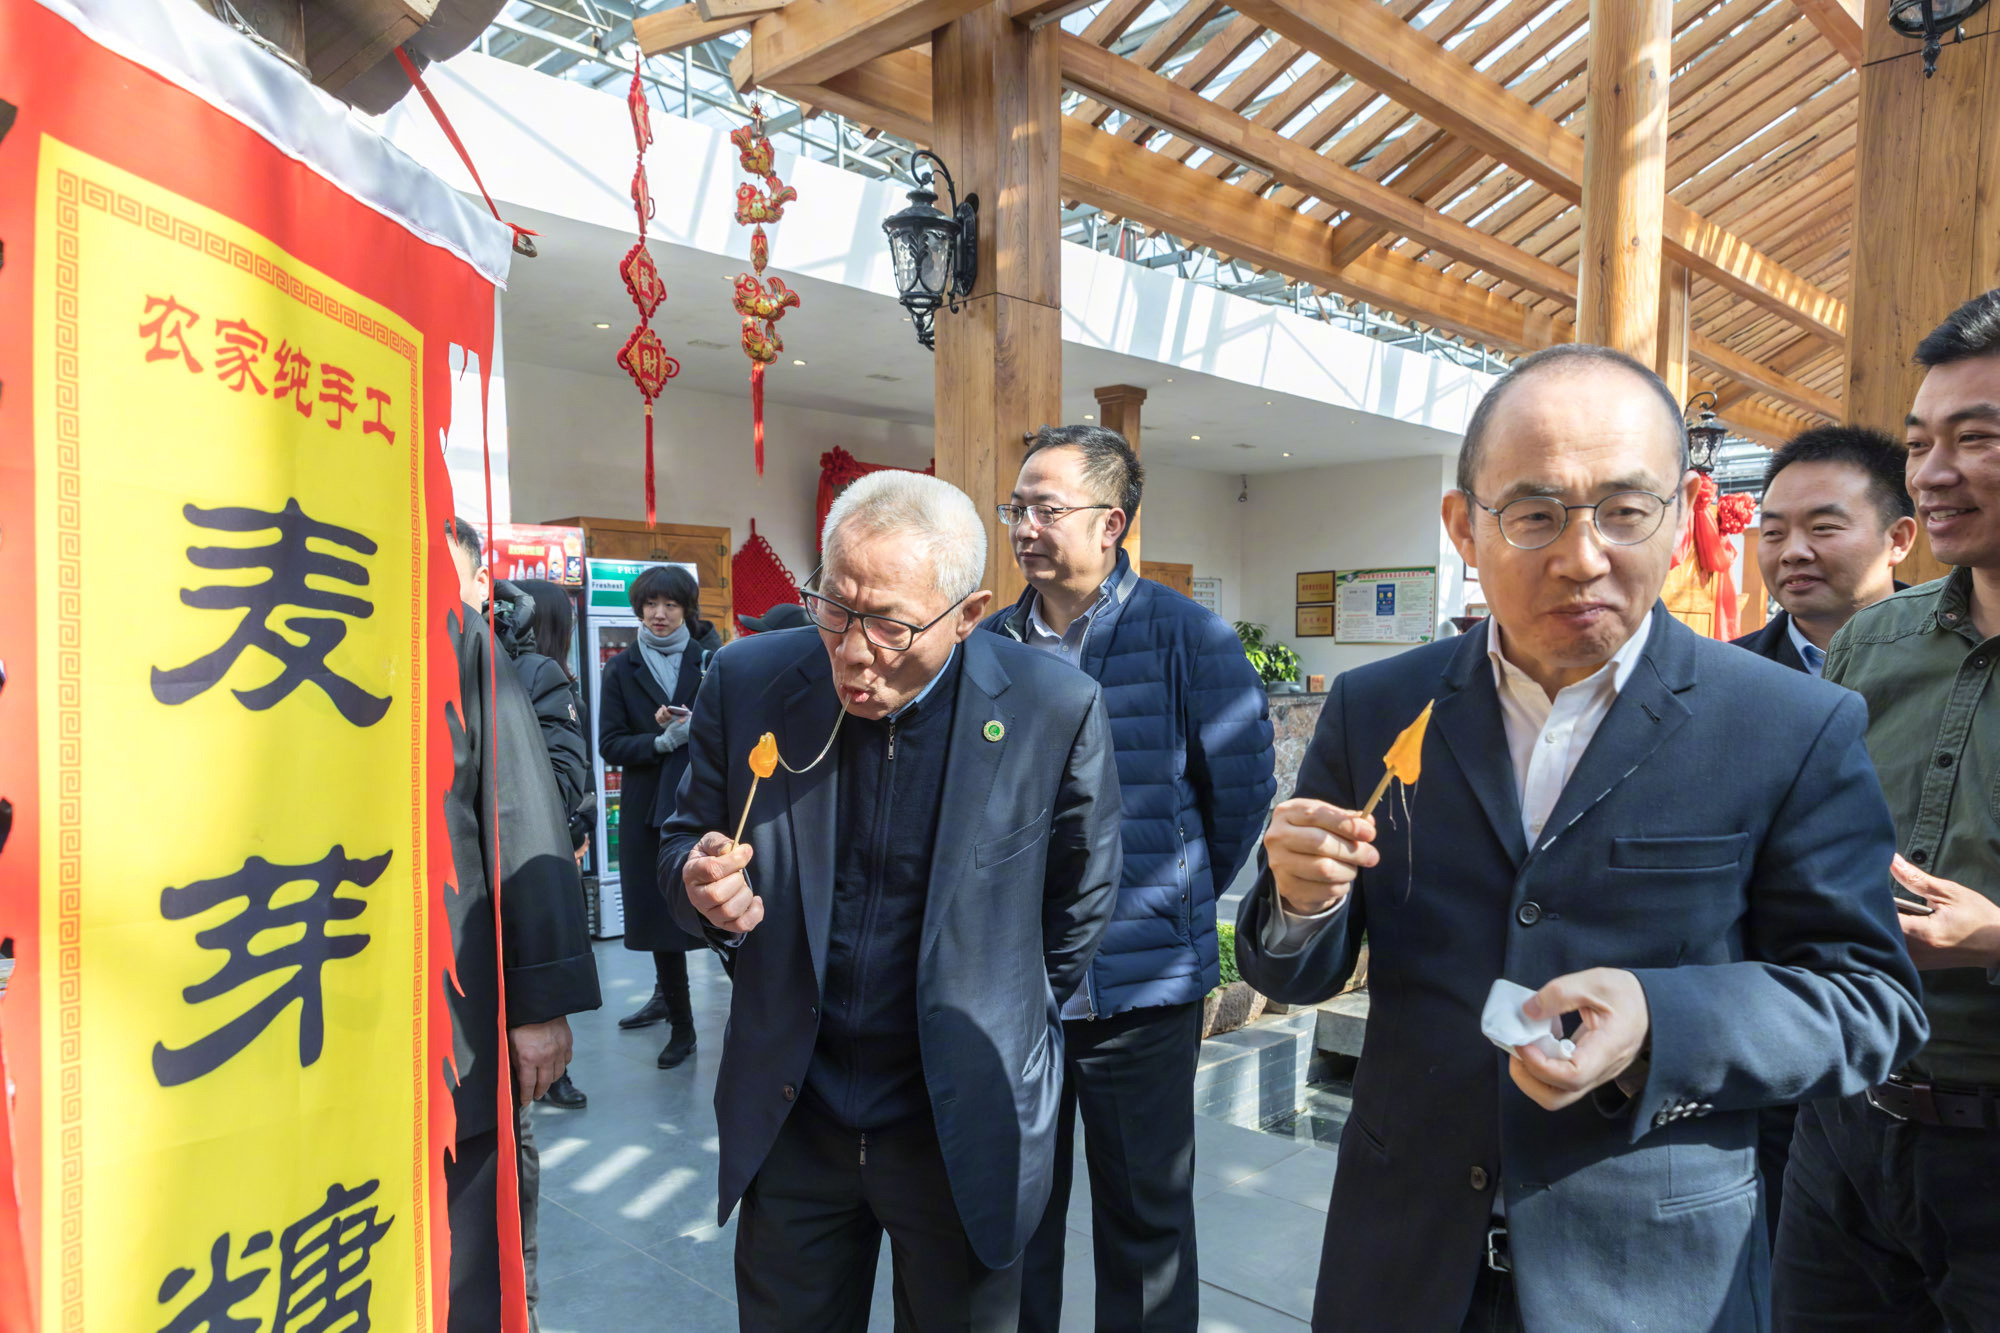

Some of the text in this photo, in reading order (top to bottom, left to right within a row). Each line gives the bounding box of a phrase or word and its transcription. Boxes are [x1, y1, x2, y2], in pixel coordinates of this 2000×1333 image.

[139, 294, 396, 446] 农家纯手工
[642, 349, 658, 379] 財
[592, 581, 624, 589] Freshest
[150, 497, 394, 1333] 麦芽糖
